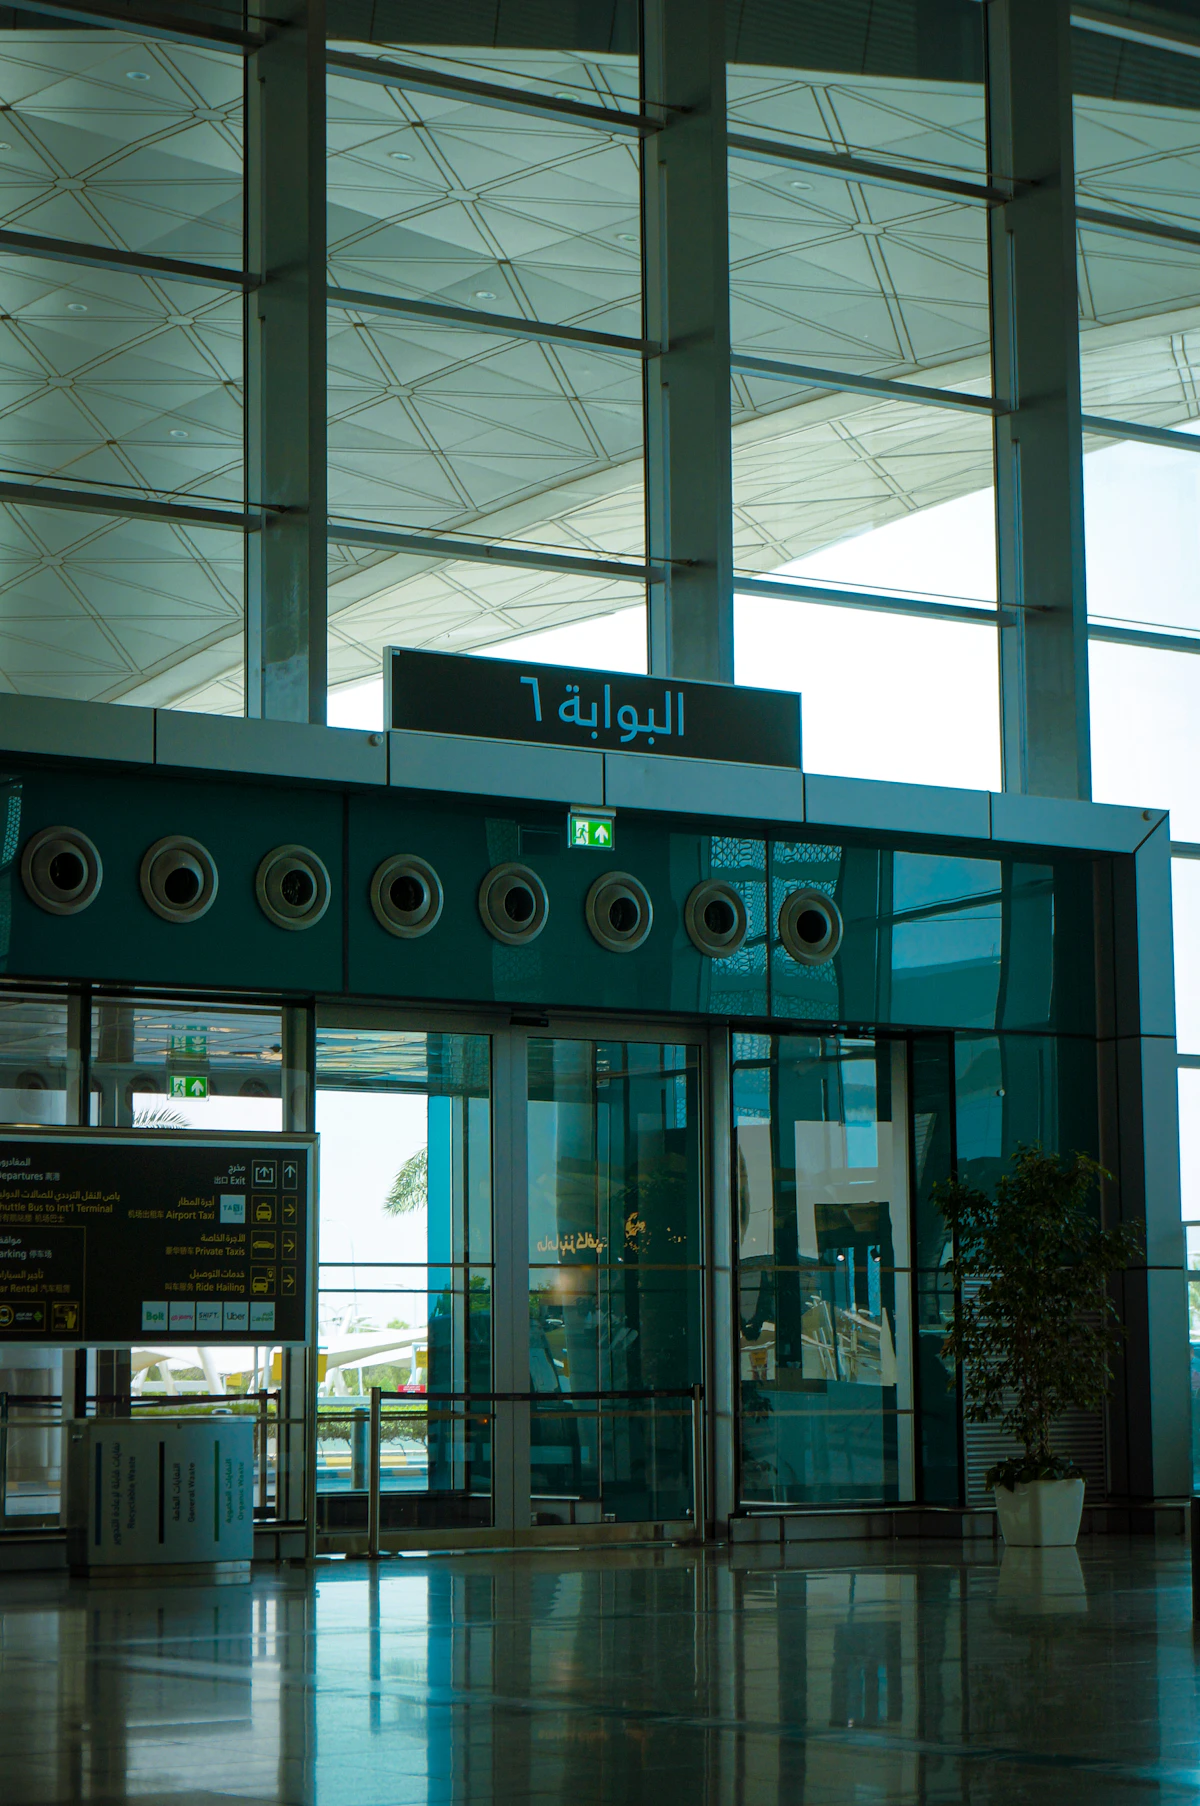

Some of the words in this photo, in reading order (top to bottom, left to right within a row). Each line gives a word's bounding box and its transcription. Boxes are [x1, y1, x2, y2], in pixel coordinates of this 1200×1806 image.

[519, 676, 543, 722] ٦
[558, 683, 685, 745] البوابة
[228, 1164, 245, 1174] مخرج
[230, 1176, 245, 1185] Exit
[81, 1190, 102, 1201] النقل
[102, 1191, 121, 1202] باص
[177, 1197, 200, 1208] المطار
[201, 1196, 215, 1207] أجرة
[0, 1203, 26, 1212] huttle
[27, 1204, 43, 1213] Bus
[45, 1204, 55, 1213] to
[57, 1204, 74, 1213] Int'l
[76, 1204, 114, 1213] Terminal
[165, 1211, 196, 1222] Airport
[198, 1211, 215, 1220] Taxi
[200, 1233, 225, 1242] الخاصة
[0, 1249, 27, 1260] arking
[195, 1246, 224, 1256] Private
[225, 1246, 246, 1256] Taxis
[189, 1269, 220, 1280] التوصيل
[221, 1269, 245, 1278] خدمات
[0, 1285, 8, 1293] ar
[10, 1284, 39, 1293] Rental
[195, 1282, 214, 1291] Ride
[216, 1282, 245, 1294] Hailing
[146, 1312, 164, 1322] Bolt
[226, 1312, 246, 1321] Uber
[187, 1462, 195, 1488] Waste
[127, 1483, 136, 1528] Recyclable
[187, 1490, 195, 1522] General
